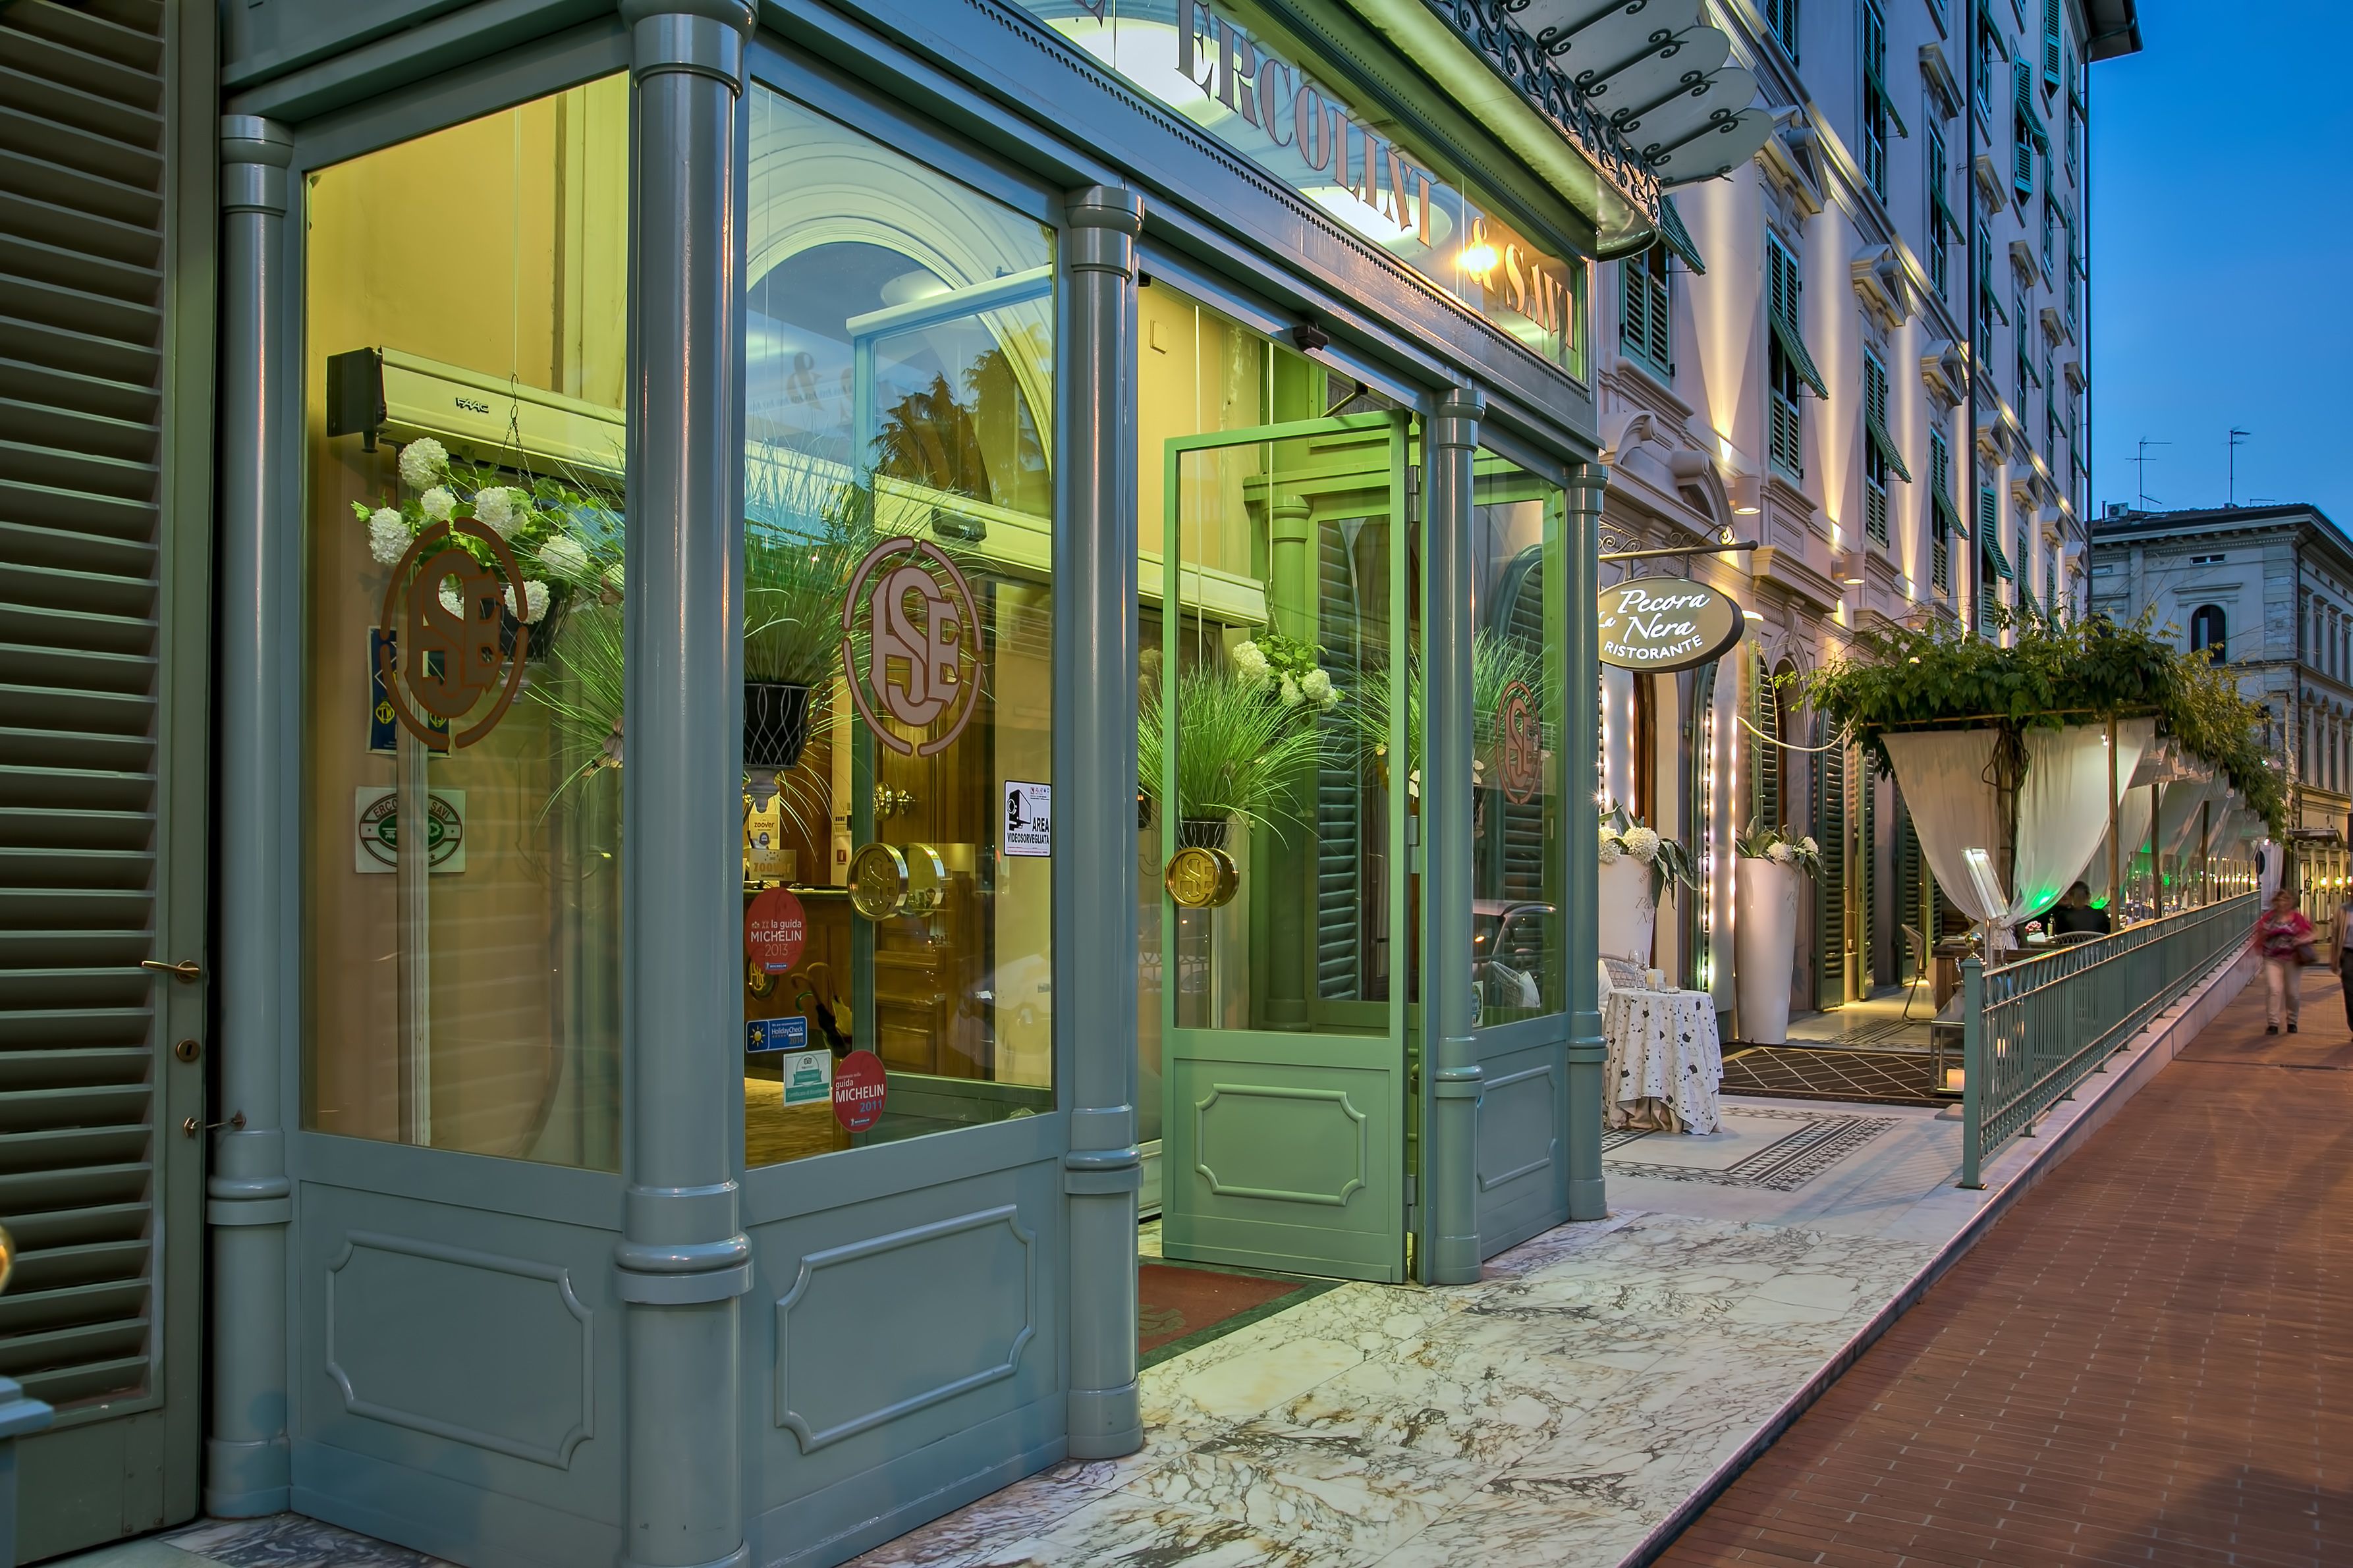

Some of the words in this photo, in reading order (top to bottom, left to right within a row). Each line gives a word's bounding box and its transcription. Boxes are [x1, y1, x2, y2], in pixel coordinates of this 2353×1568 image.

[1175, 0, 1432, 249] ERCOLINI
[1505, 243, 1576, 352] SAVI
[456, 398, 489, 413] FAAC
[1617, 589, 1711, 614] Pecora
[1623, 612, 1696, 643] Nera
[1604, 634, 1703, 659] RISTORANTE
[430, 801, 451, 819] SAVI
[1032, 817, 1049, 832] AREA
[1007, 832, 1049, 844] VIDEOSORVEGLIATA
[771, 919, 778, 928] la
[780, 919, 802, 930] guida
[751, 931, 802, 942] MICHELIN
[765, 943, 788, 956] 2013
[771, 1025, 803, 1035] HolidayCheck
[836, 1079, 854, 1090] guida
[836, 1084, 884, 1103] MICHELIN
[860, 1099, 882, 1112] 2011
